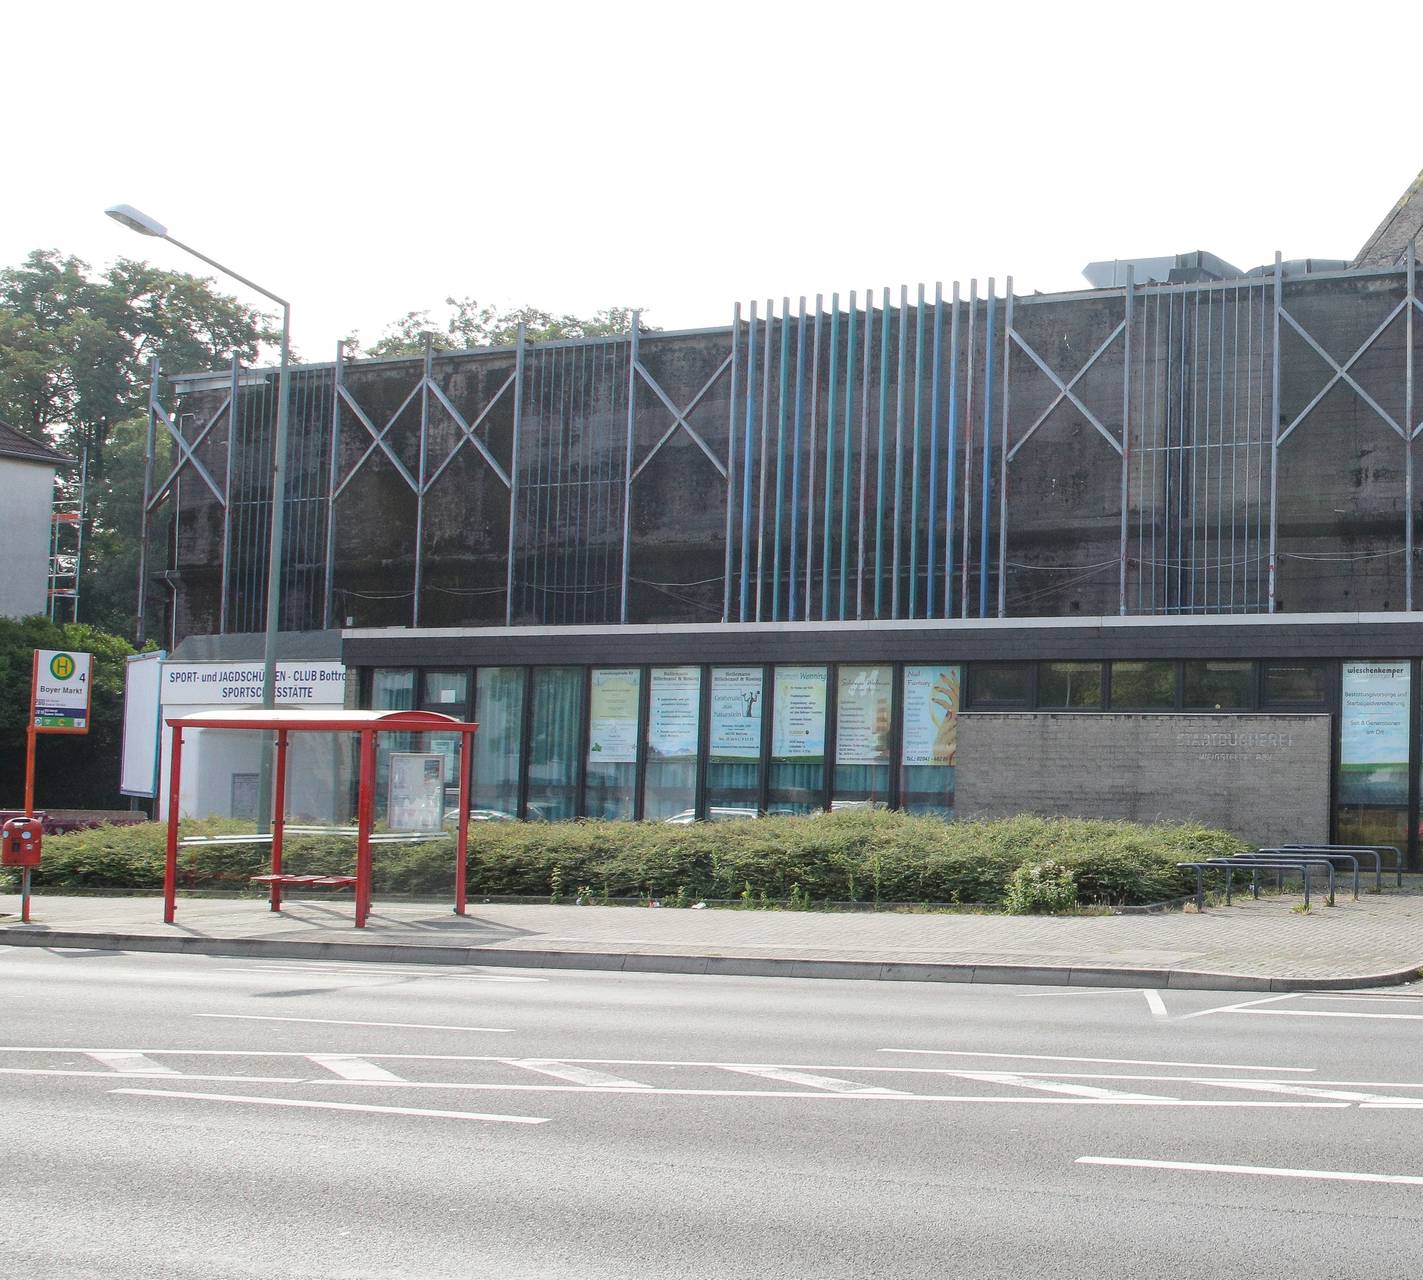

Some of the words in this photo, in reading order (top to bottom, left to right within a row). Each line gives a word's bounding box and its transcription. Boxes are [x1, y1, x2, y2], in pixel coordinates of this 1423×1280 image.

[80, 672, 86, 683] 4
[170, 671, 200, 682] SPORT-
[202, 671, 216, 682] und
[218, 668, 286, 682] JAGDSCHÜEN
[294, 670, 316, 682] CLUB
[320, 670, 346, 682] Bottro
[1348, 667, 1404, 678] wieschenkemper
[40, 686, 60, 694] Boyer
